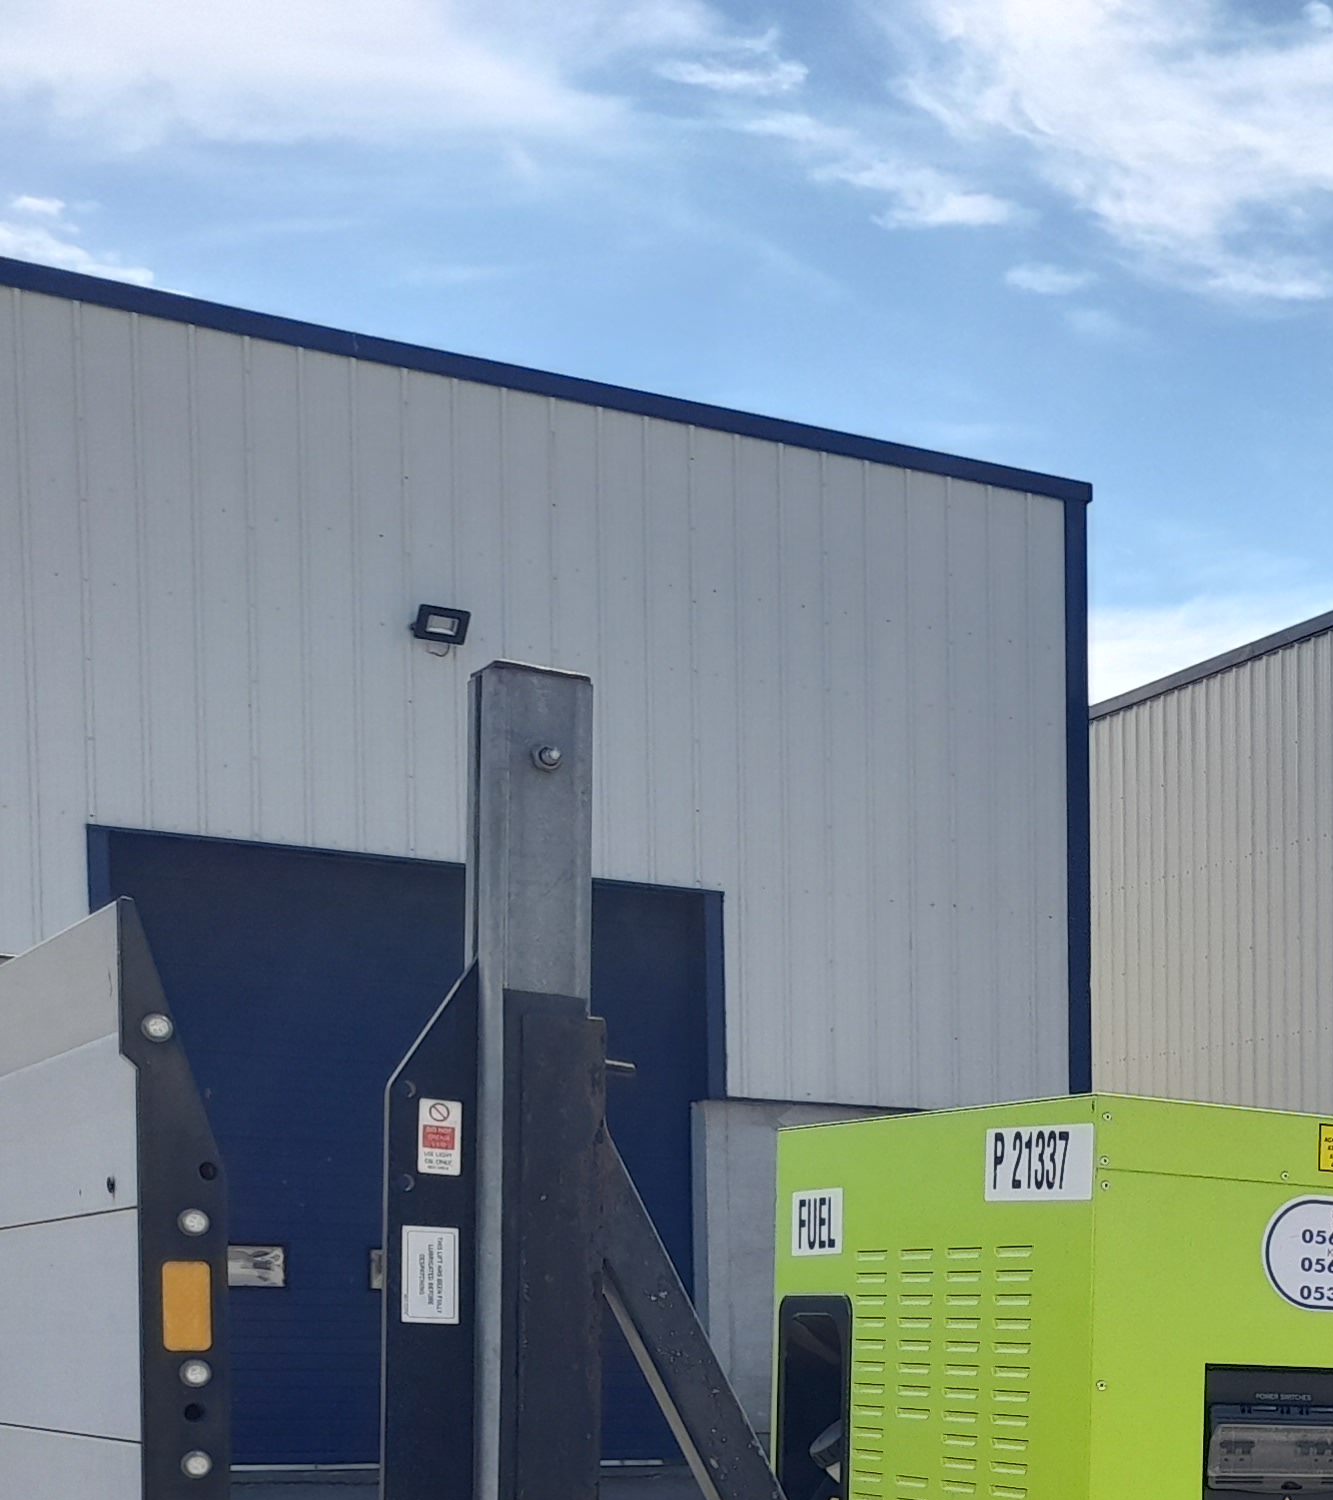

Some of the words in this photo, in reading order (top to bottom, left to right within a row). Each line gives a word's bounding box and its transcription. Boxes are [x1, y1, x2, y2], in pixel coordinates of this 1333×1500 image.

[992, 1132, 1005, 1190] P
[1011, 1130, 1070, 1190] 21337
[798, 1197, 836, 1250] FUEL
